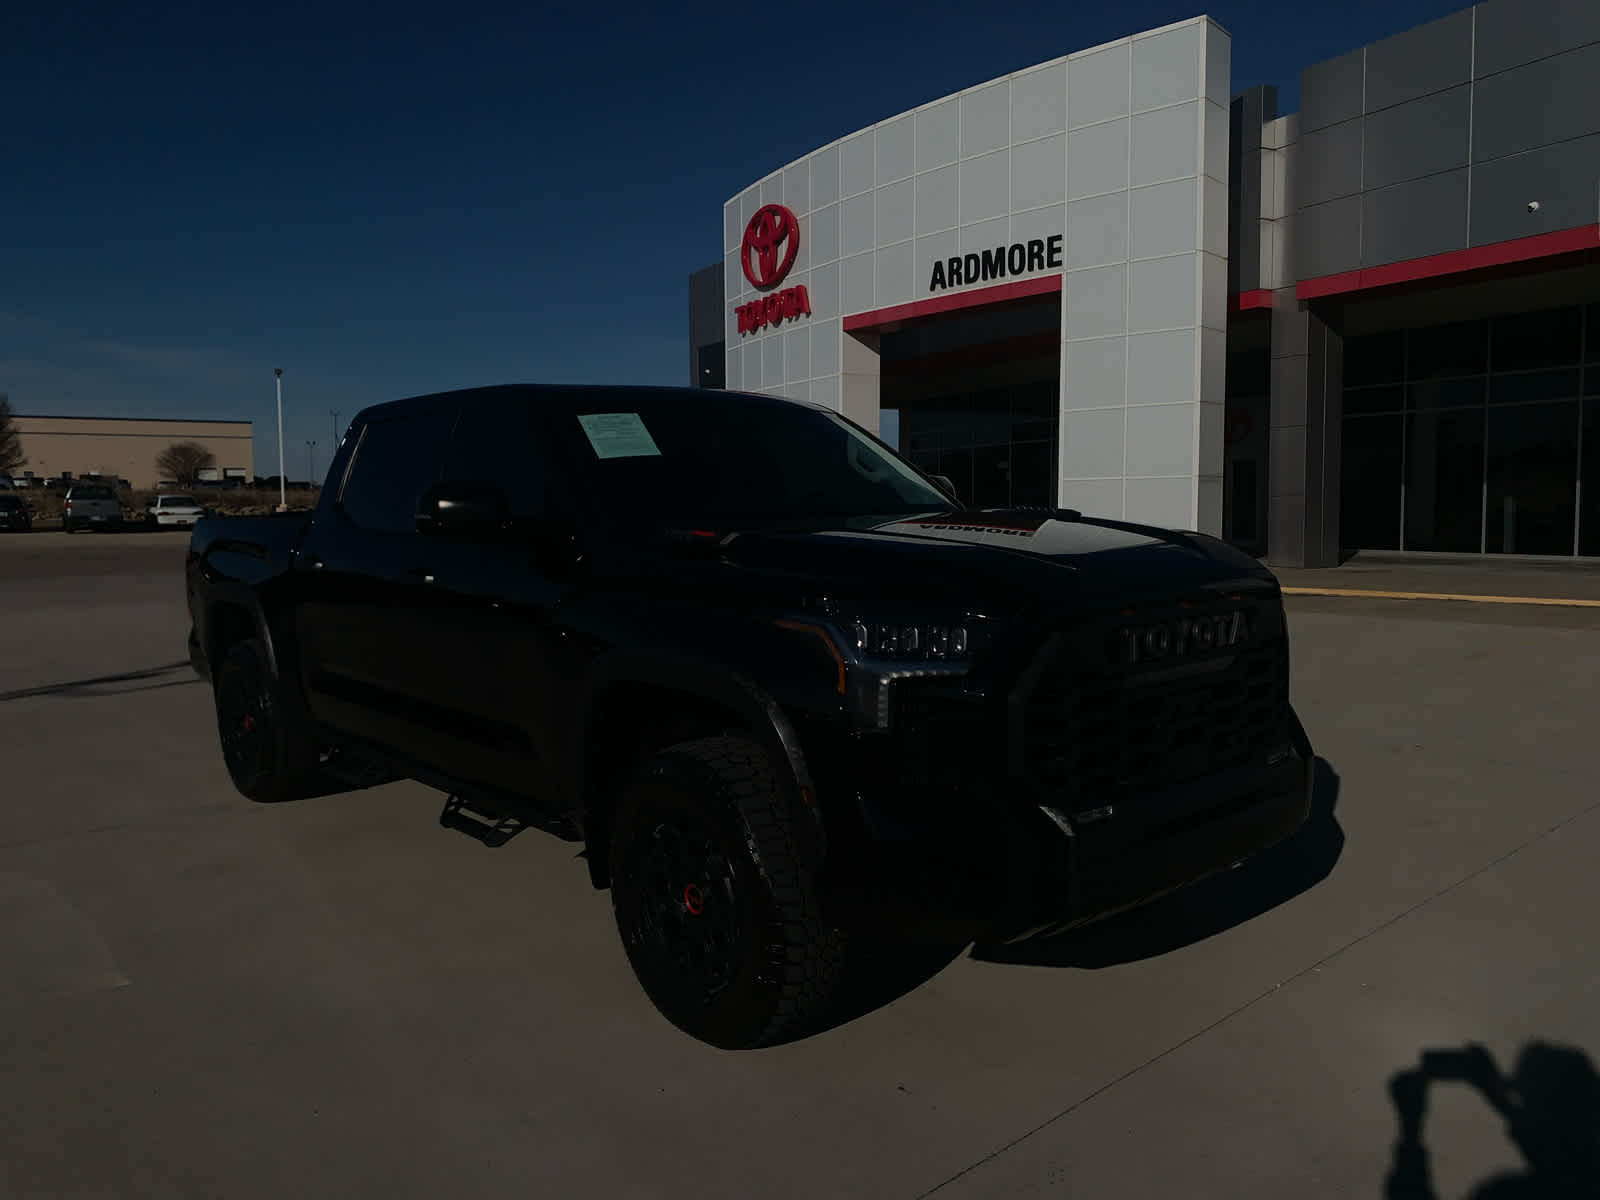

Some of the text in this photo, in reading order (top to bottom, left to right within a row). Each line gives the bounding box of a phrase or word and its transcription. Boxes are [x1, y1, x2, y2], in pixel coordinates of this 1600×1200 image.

[930, 234, 1063, 291] ARDMORE
[735, 285, 811, 336] TOYOTA
[1121, 608, 1250, 664] TOYOTA
